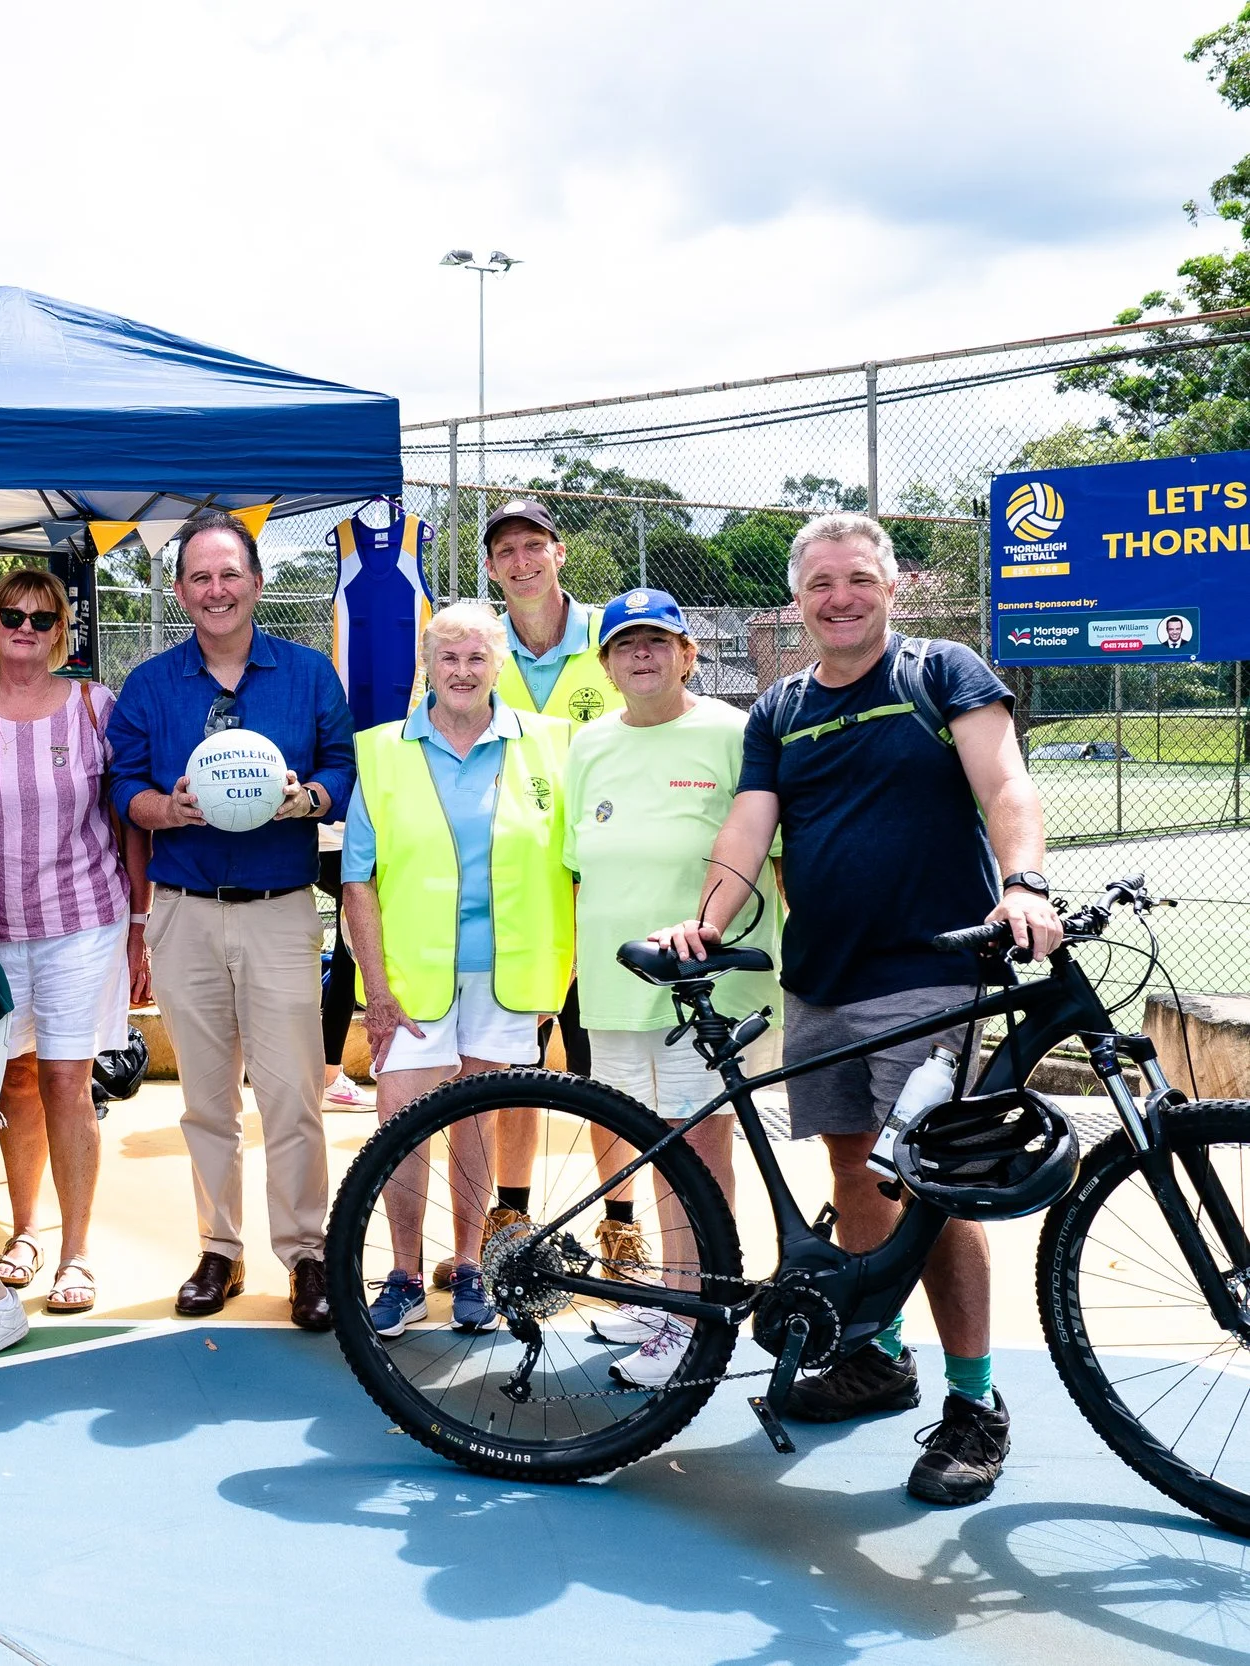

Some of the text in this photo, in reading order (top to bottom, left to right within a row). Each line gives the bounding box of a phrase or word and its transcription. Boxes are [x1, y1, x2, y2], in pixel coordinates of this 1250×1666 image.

[1148, 481, 1247, 516] LET'S
[1003, 542, 1067, 554] THORNLEIGH
[1013, 551, 1057, 562] NETBALL
[1012, 567, 1032, 576] EST.
[997, 599, 1098, 610] Banners Sponsored by:
[1033, 626, 1079, 637] Mortgage
[1118, 623, 1149, 631] Williams
[1033, 637, 1067, 646] Choice
[197, 749, 277, 768] THORNLEIGH
[211, 768, 270, 781] NETBALL
[669, 780, 717, 789] PROUD POPPY
[226, 787, 262, 799] CLUB
[1052, 1177, 1098, 1344] GROUND CONTROL GRID
[430, 1423, 531, 1463] BUTCHER GRID T9
